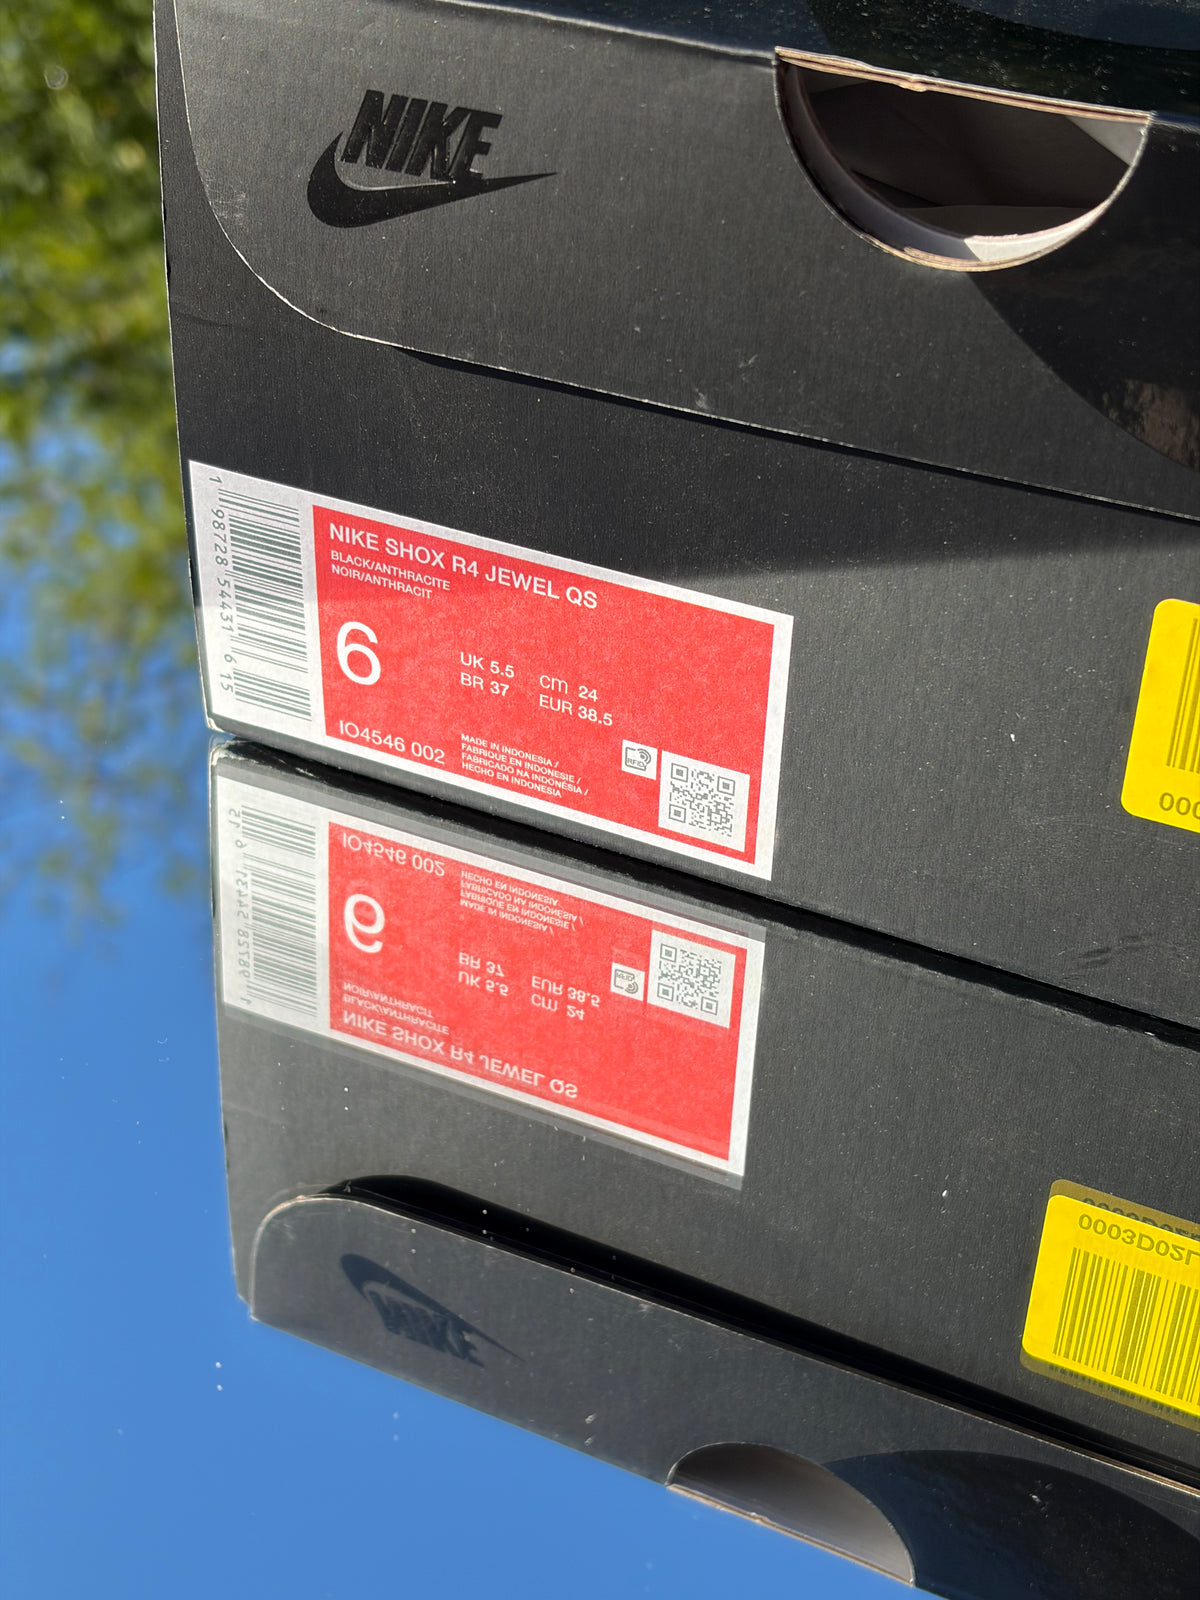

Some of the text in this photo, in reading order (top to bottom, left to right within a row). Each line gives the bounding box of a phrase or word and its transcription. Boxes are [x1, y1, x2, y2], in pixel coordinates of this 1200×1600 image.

[340, 89, 502, 181] NIKE
[211, 508, 228, 567] 98728
[329, 523, 598, 609] NIKE SHOX R4 JEWEL QS
[331, 550, 451, 591] BLACK/ANTHRACITE
[332, 565, 433, 599] NOIR/ANTHRACIT
[218, 578, 233, 633] 54431
[224, 653, 237, 664] 6
[336, 621, 381, 685] 6
[461, 652, 515, 678] UK 5.5
[220, 672, 233, 692] 15
[461, 672, 510, 697] BR 37
[540, 674, 598, 702] cm 24
[539, 694, 613, 726] EUR 38.5
[340, 719, 445, 764] IO4546 002
[461, 733, 488, 748] MADE
[490, 742, 500, 752] IN
[502, 745, 553, 767] INDONESIA
[461, 743, 508, 762] FABRIQUE
[509, 757, 522, 767] EN
[524, 761, 575, 783] INDONESIE
[461, 752, 515, 774] FABRICADO
[516, 768, 530, 779] NA
[532, 772, 582, 794] INDONÉSIA
[461, 762, 562, 798] HECHO EN INDONESIA
[627, 757, 645, 768] RFID
